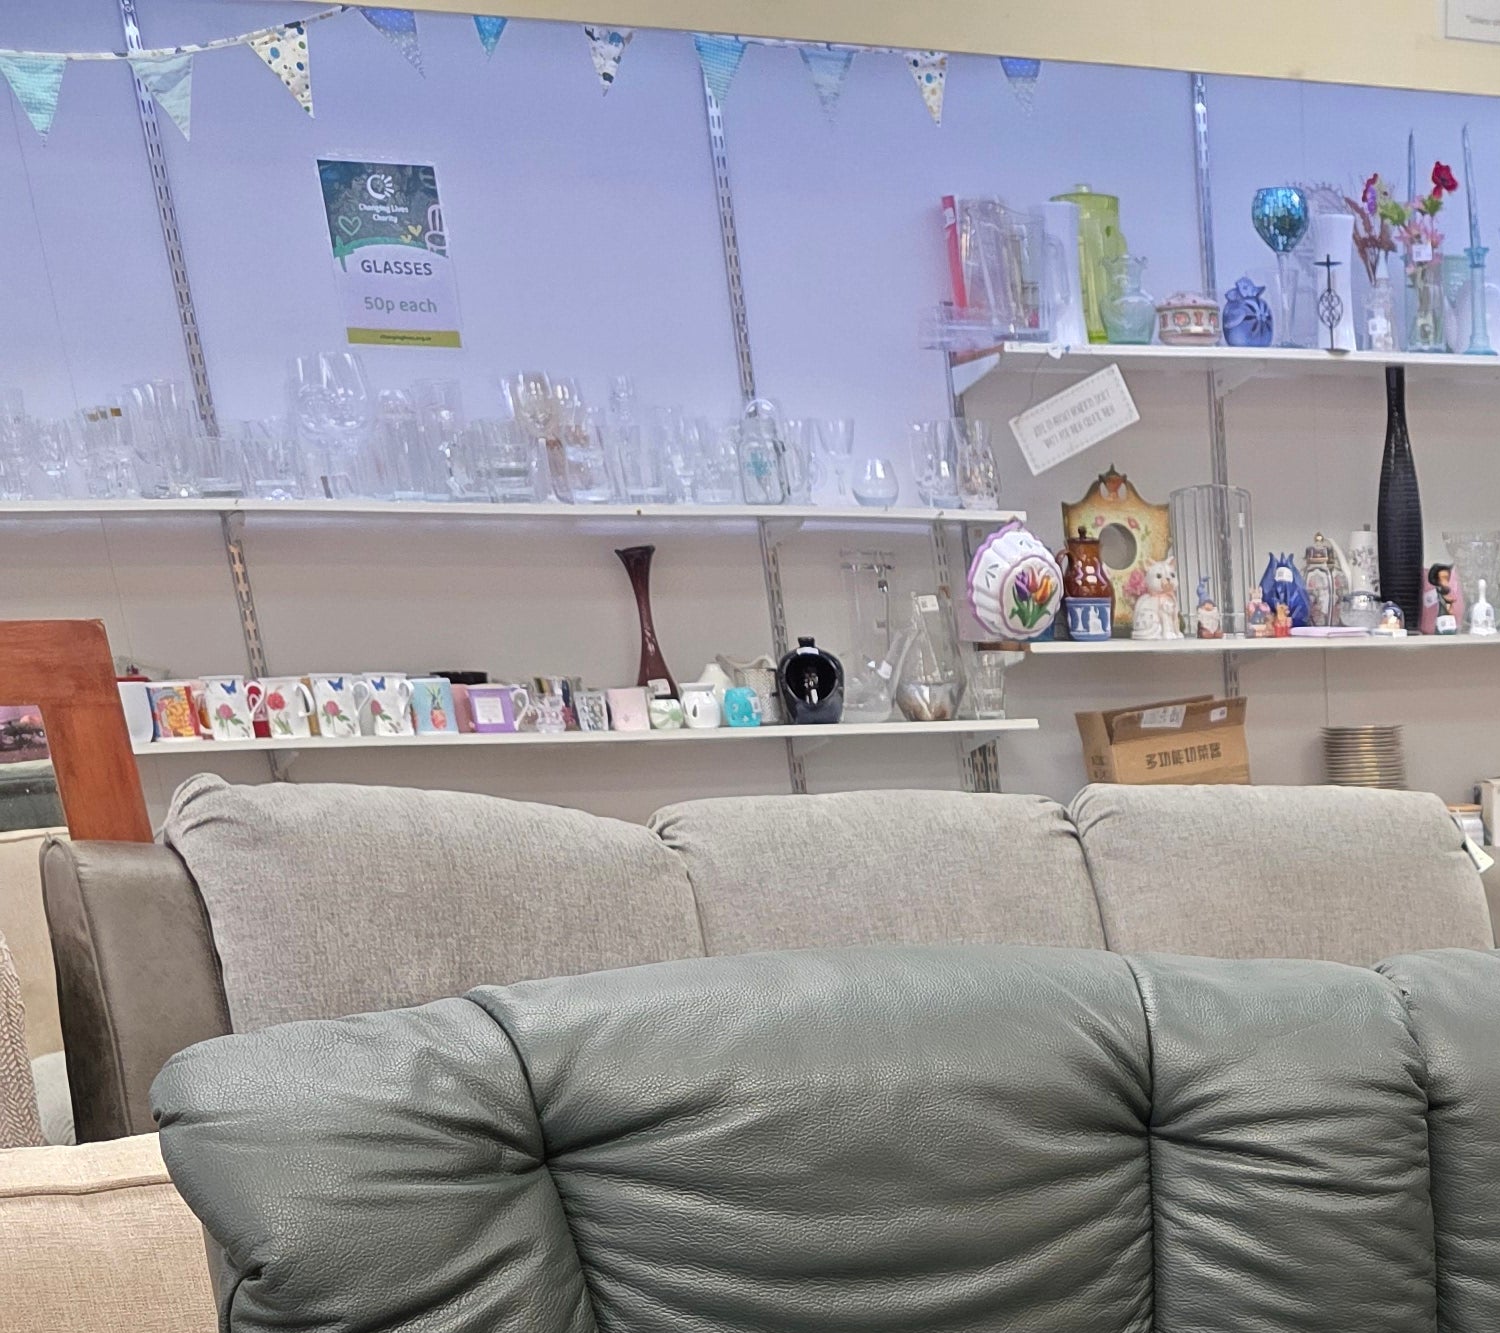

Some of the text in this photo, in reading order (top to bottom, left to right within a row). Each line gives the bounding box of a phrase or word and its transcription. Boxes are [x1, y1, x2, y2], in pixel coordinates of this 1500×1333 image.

[359, 203, 408, 223] Changing Lives Charity
[361, 259, 433, 276] GLASSES
[364, 297, 437, 314] 50p each
